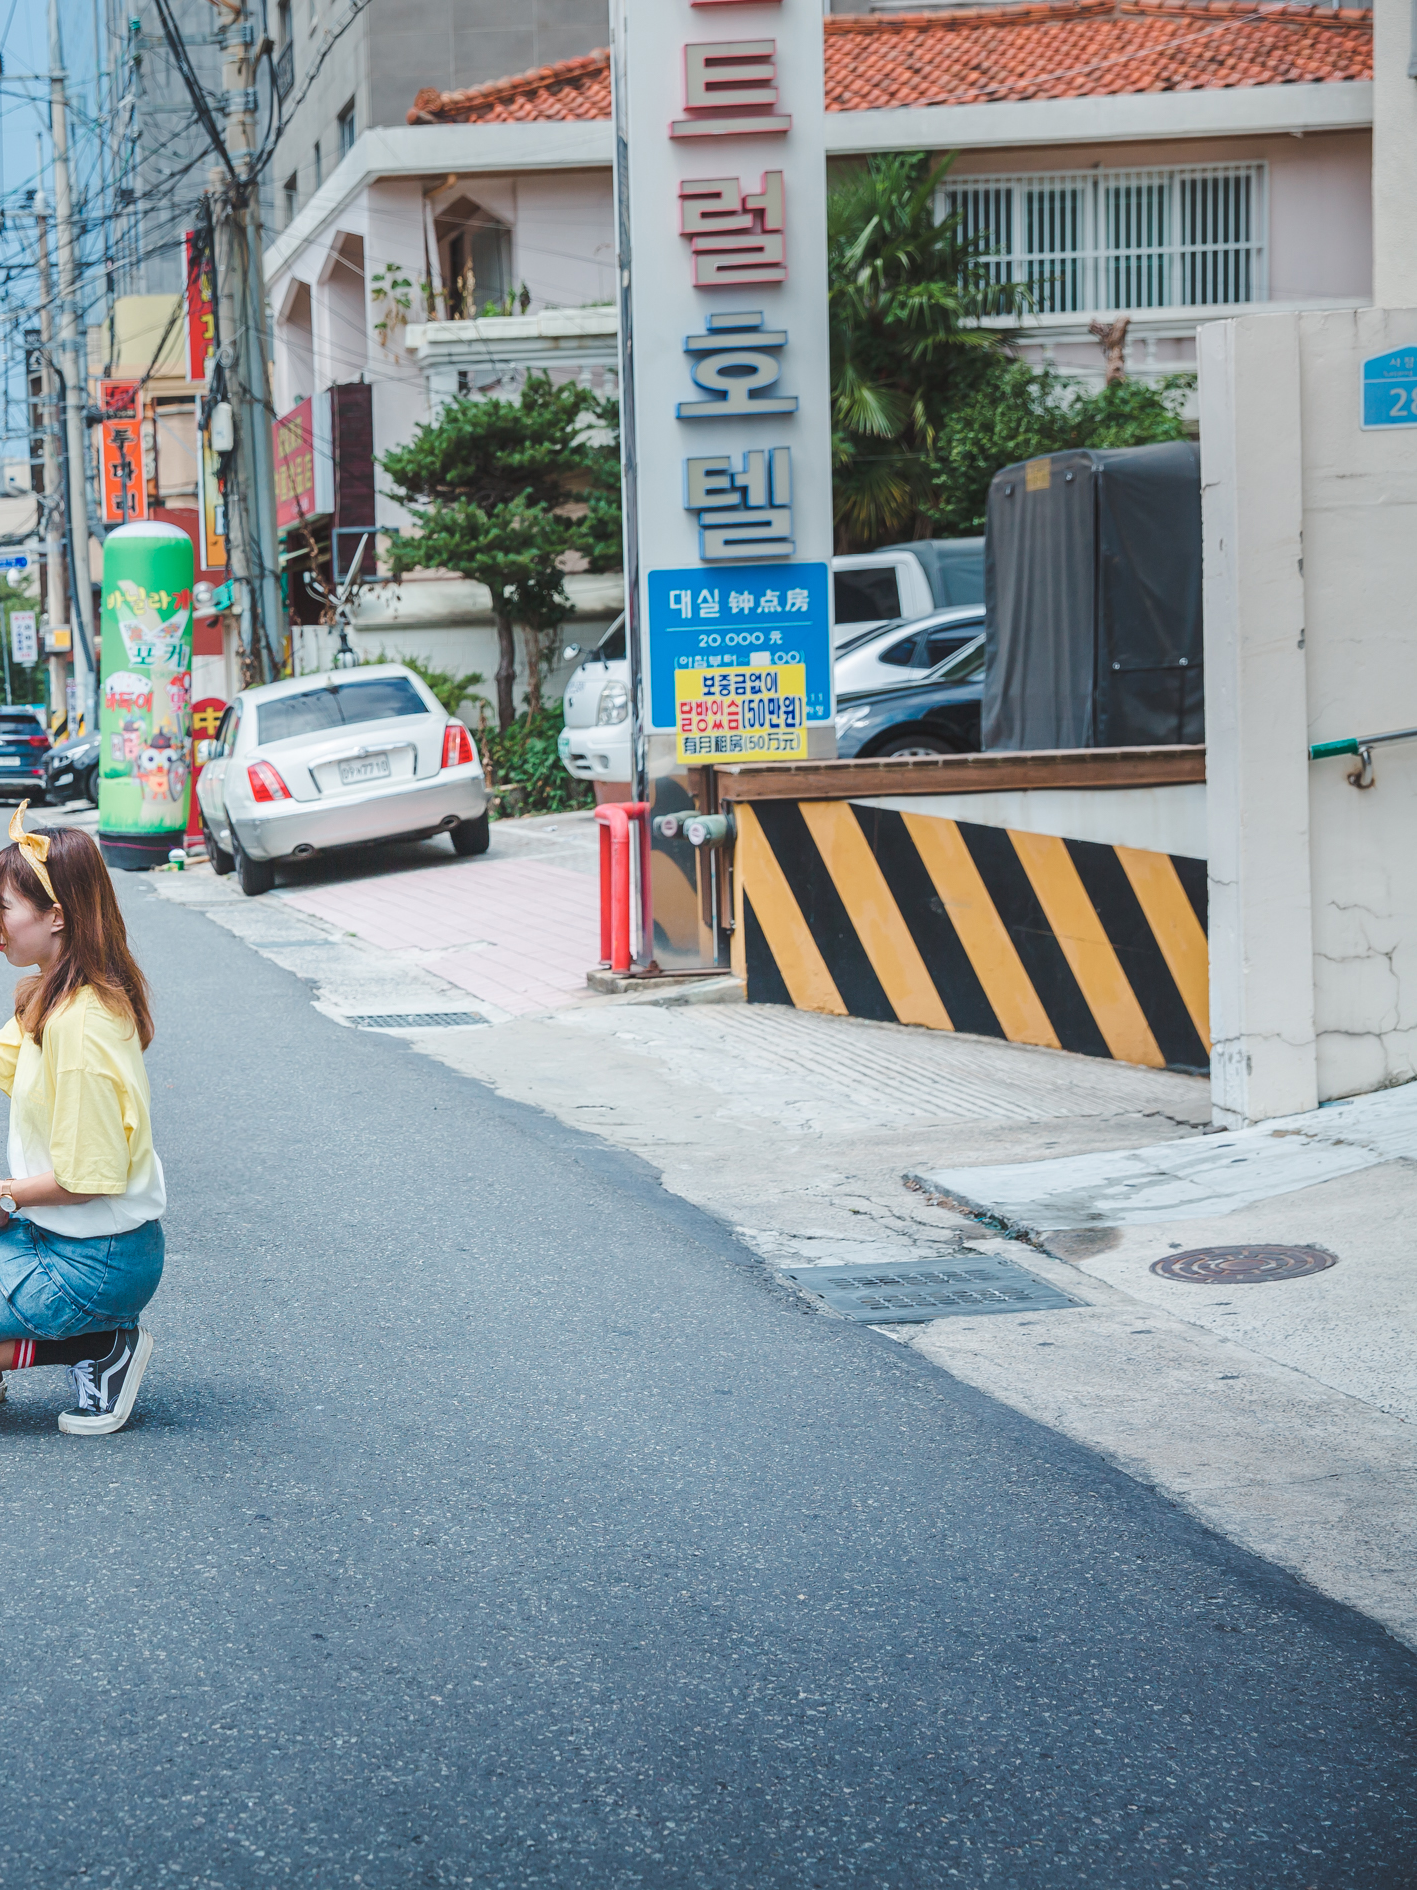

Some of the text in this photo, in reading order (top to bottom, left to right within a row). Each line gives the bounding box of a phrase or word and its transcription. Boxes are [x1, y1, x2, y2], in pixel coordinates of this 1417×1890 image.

[675, 310, 800, 560] 호텔
[669, 587, 810, 619] 대실 钟点房
[769, 630, 783, 645] 元
[703, 671, 778, 697] 보증금없이
[105, 691, 153, 713] 바둑이
